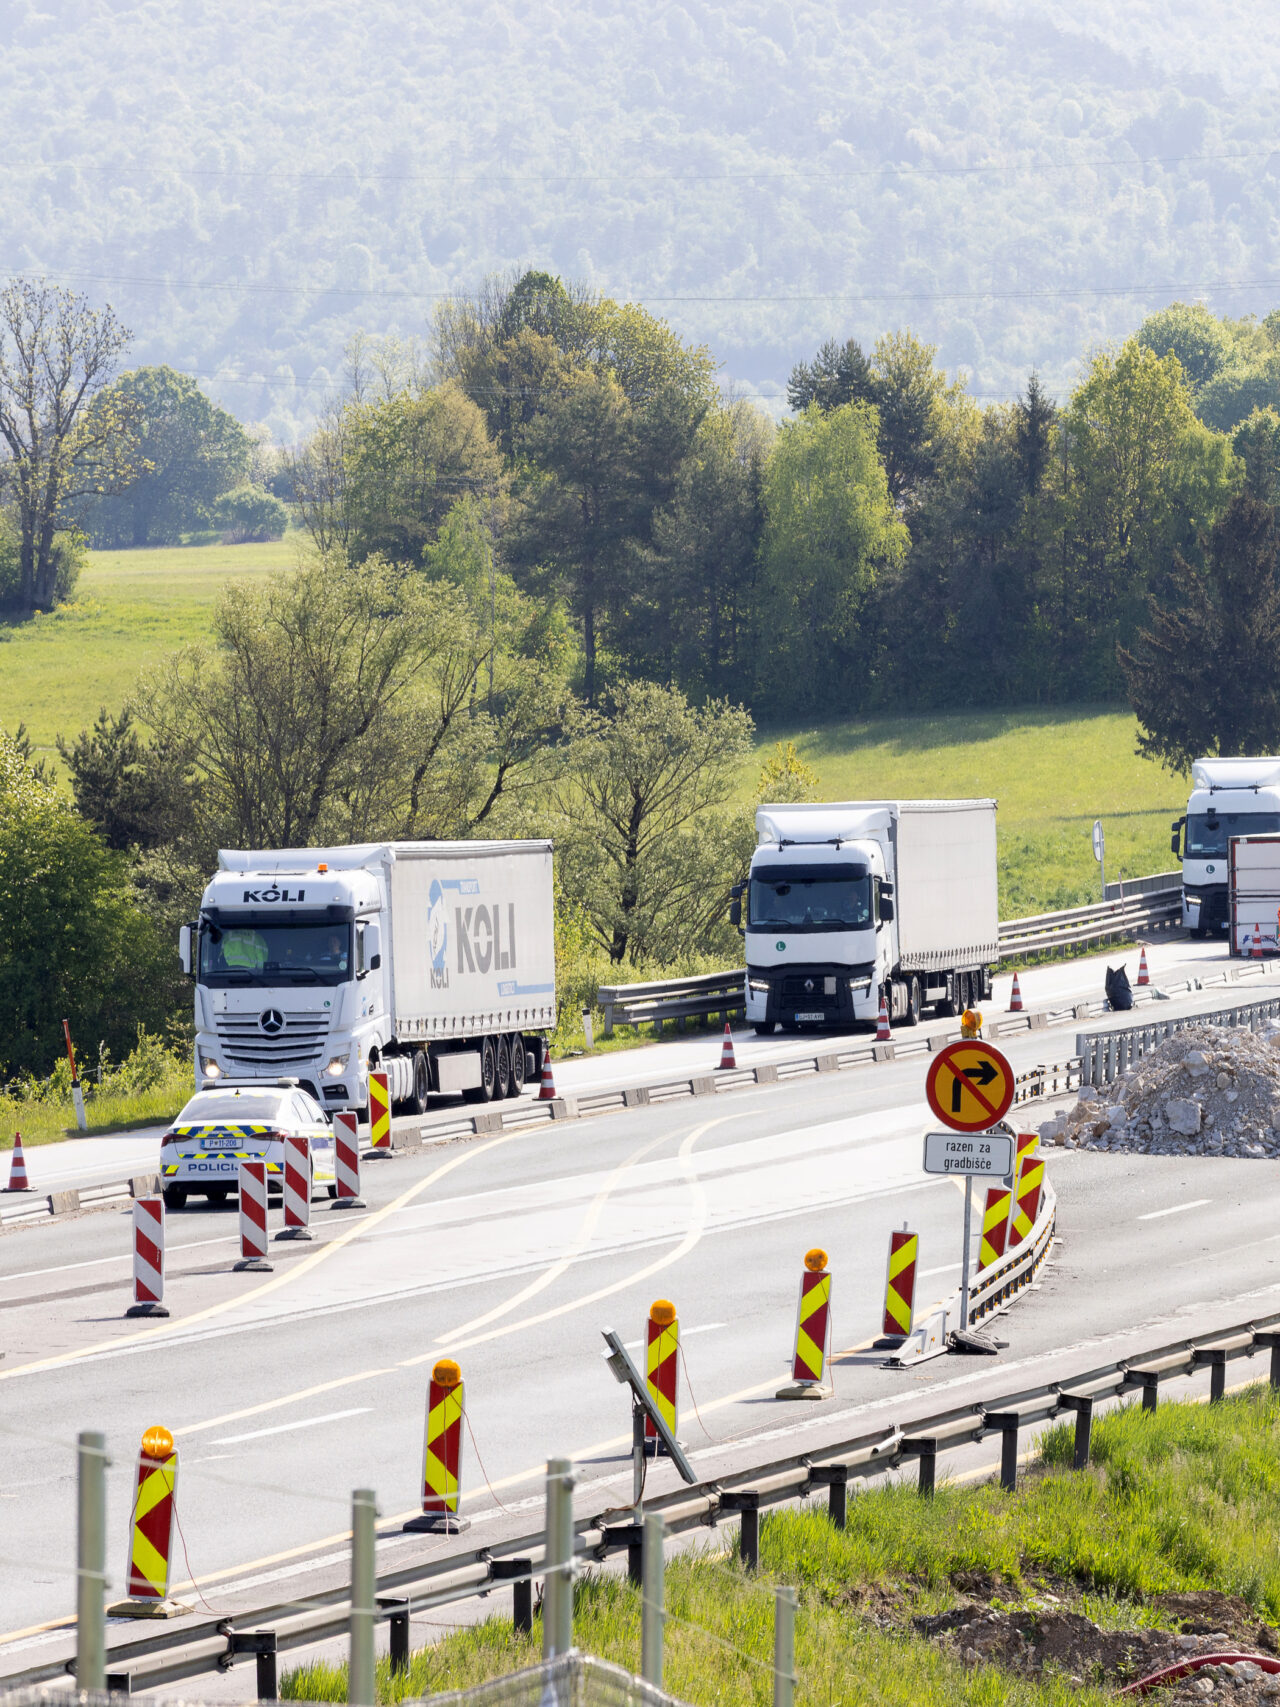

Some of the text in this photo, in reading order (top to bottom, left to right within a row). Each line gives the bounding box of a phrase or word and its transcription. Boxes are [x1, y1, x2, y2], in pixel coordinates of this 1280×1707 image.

[243, 889, 305, 903] KOLI
[455, 903, 517, 974] KOLI
[430, 967, 450, 990] KOLI
[209, 1139, 214, 1147] P
[945, 1142, 991, 1154] razen za
[188, 1163, 238, 1172] POLICI
[943, 1157, 992, 1171] gradbišče
